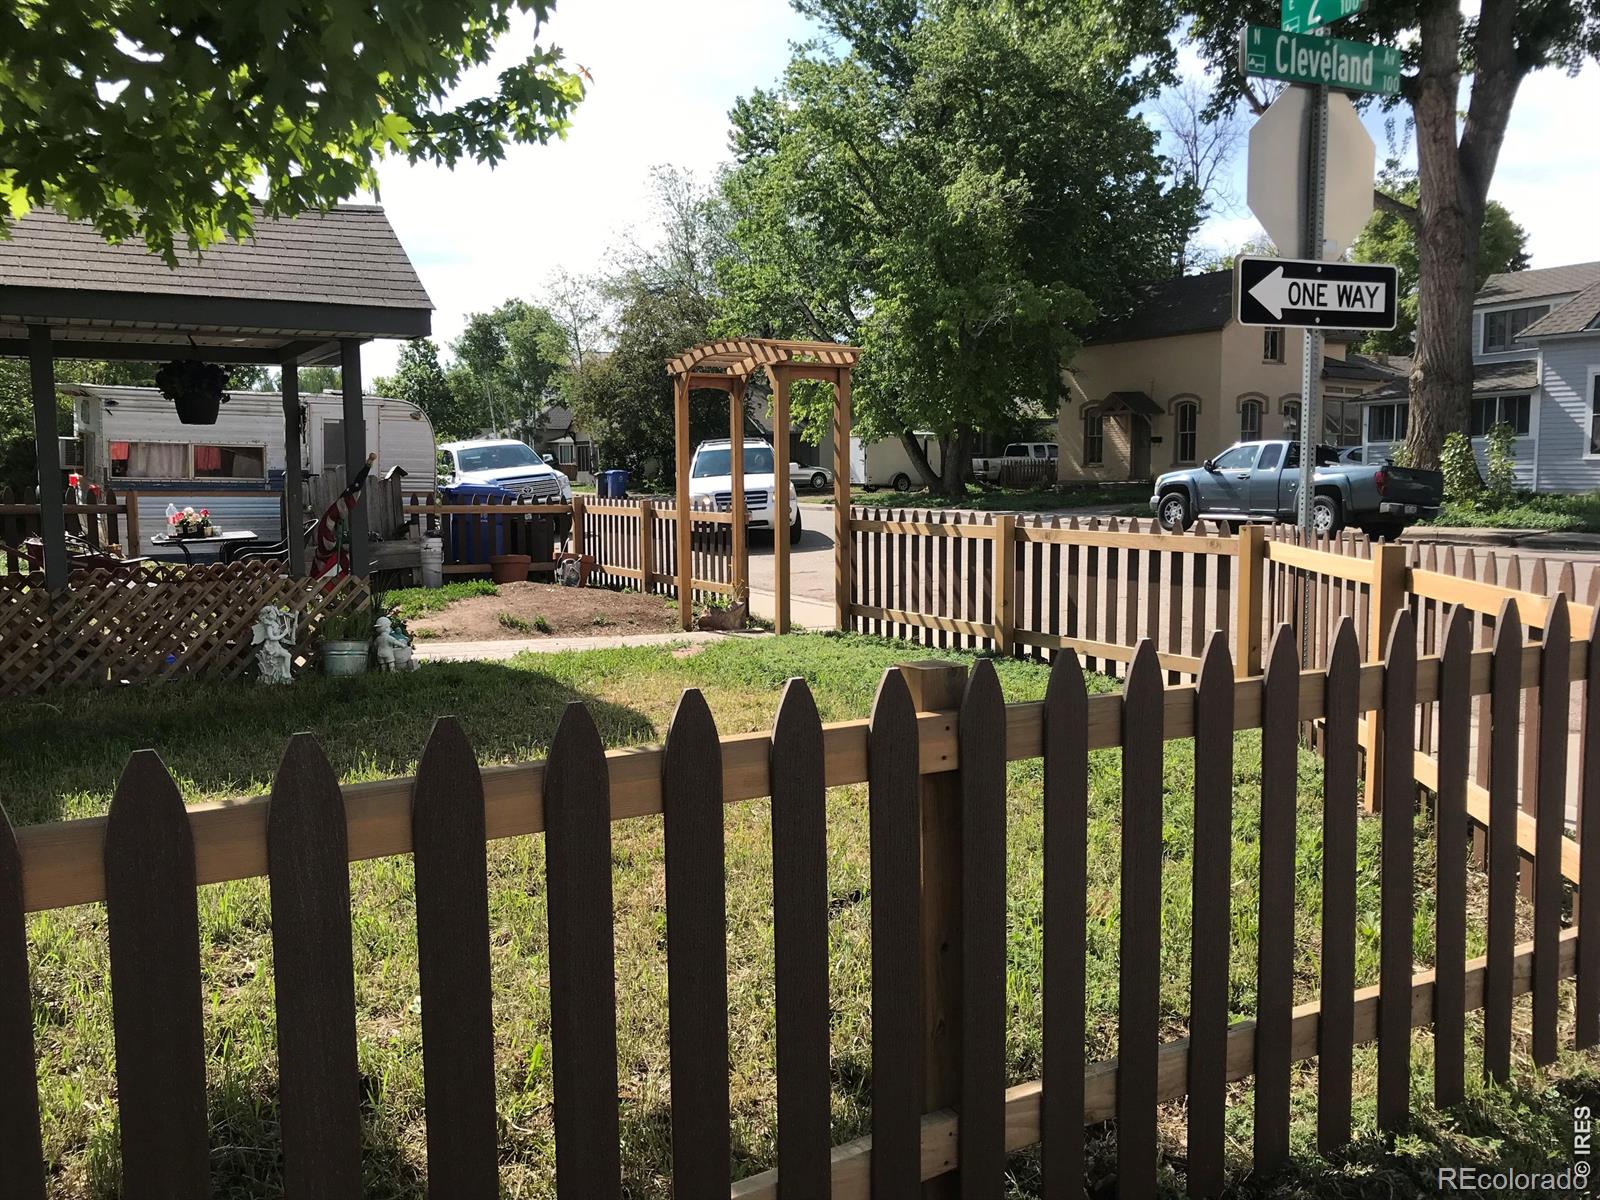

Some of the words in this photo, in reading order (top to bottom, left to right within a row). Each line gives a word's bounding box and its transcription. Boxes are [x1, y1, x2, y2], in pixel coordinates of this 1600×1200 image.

[1253, 28, 1261, 45] N
[1275, 35, 1373, 86] Cleveland
[1383, 75, 1399, 92] 100
[1288, 281, 1328, 306] ONE
[1337, 284, 1379, 309] WAY
